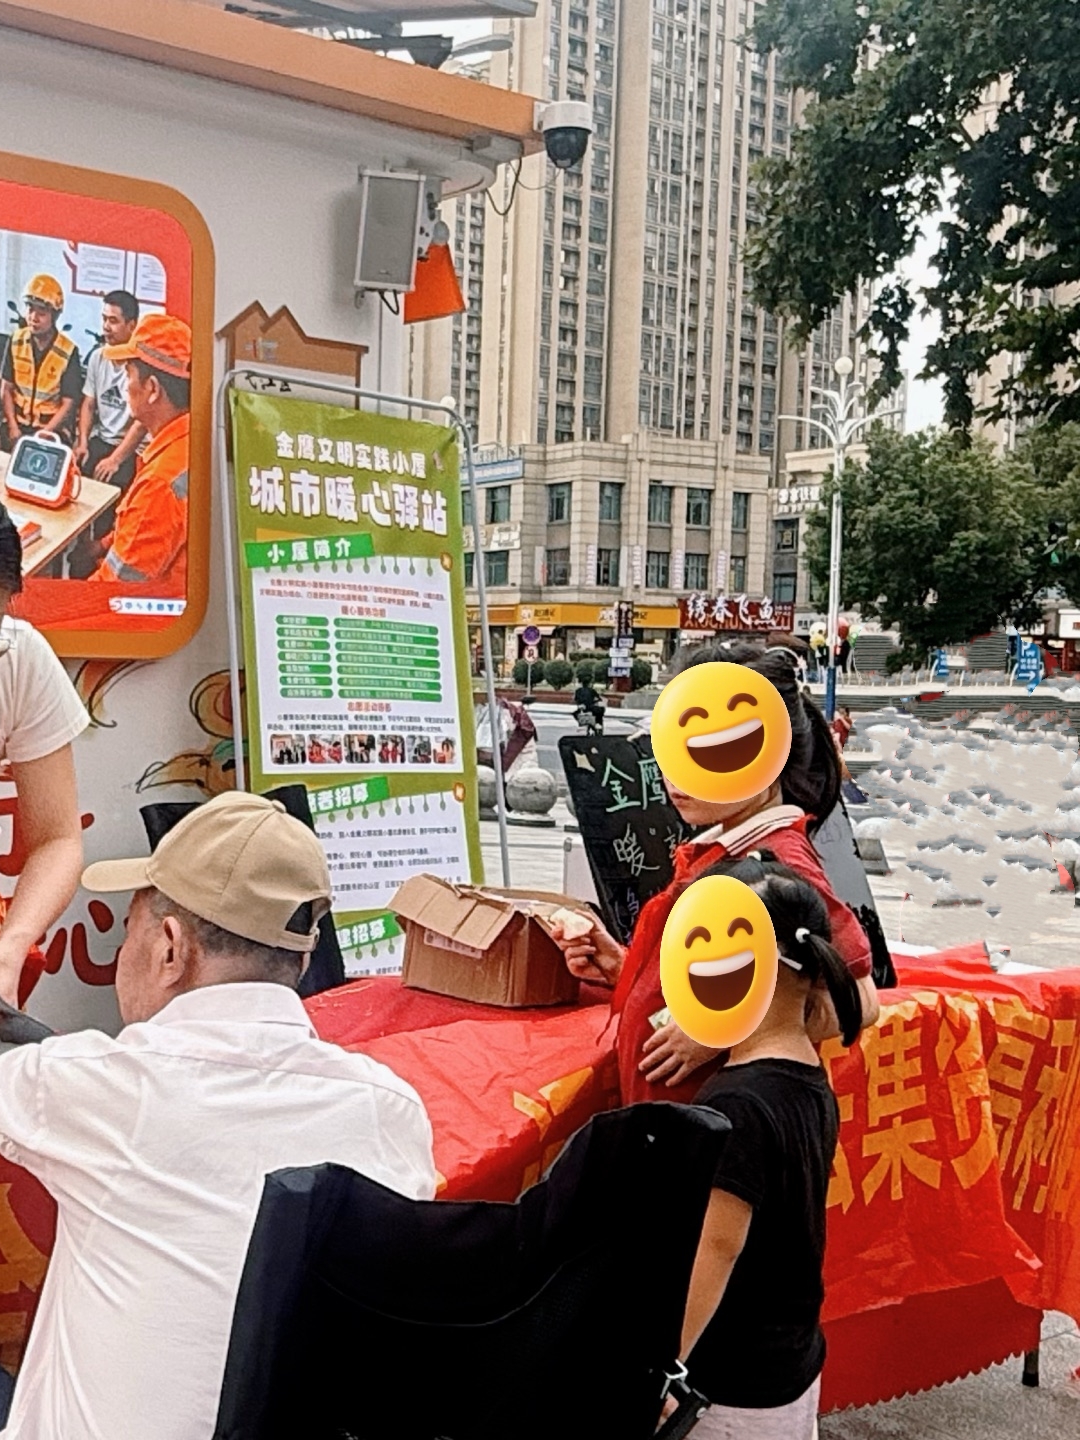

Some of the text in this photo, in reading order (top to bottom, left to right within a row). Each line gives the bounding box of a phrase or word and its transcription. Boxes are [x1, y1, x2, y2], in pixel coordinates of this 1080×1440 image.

[275, 430, 427, 479] 金鹰文明实践小屋
[248, 466, 448, 536] 城市暖心驿站
[267, 538, 351, 563] 小屋简介
[687, 592, 775, 626] 绣春飞鱼
